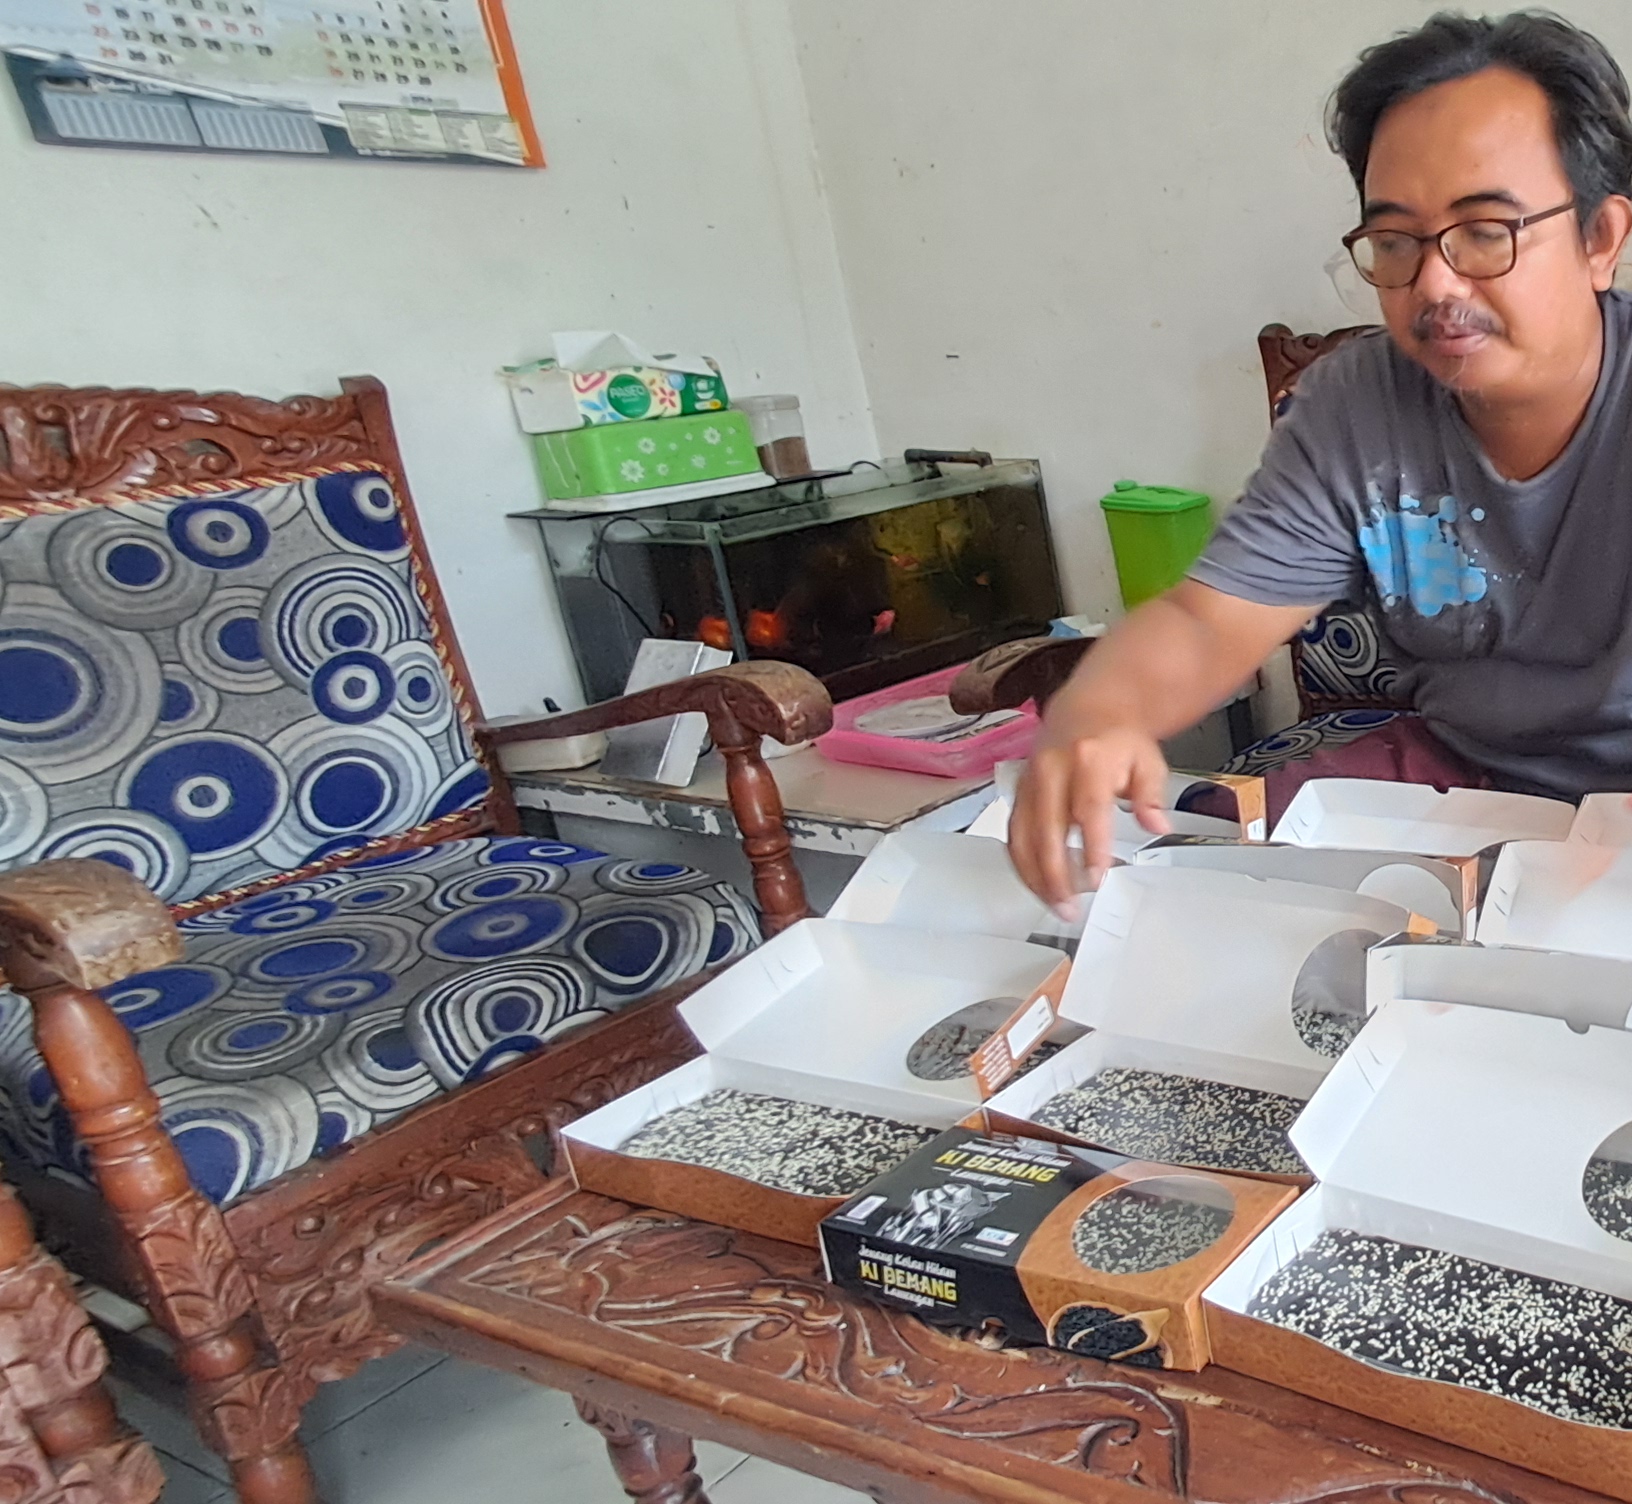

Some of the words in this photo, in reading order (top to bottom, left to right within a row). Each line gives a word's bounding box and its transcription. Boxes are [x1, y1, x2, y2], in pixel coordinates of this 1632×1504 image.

[934, 1149, 970, 1165] KI
[962, 1154, 1062, 1183] DEMANG
[858, 1244, 894, 1266] Jenang
[860, 1259, 878, 1281] KI
[883, 1265, 958, 1302] DEMANG
